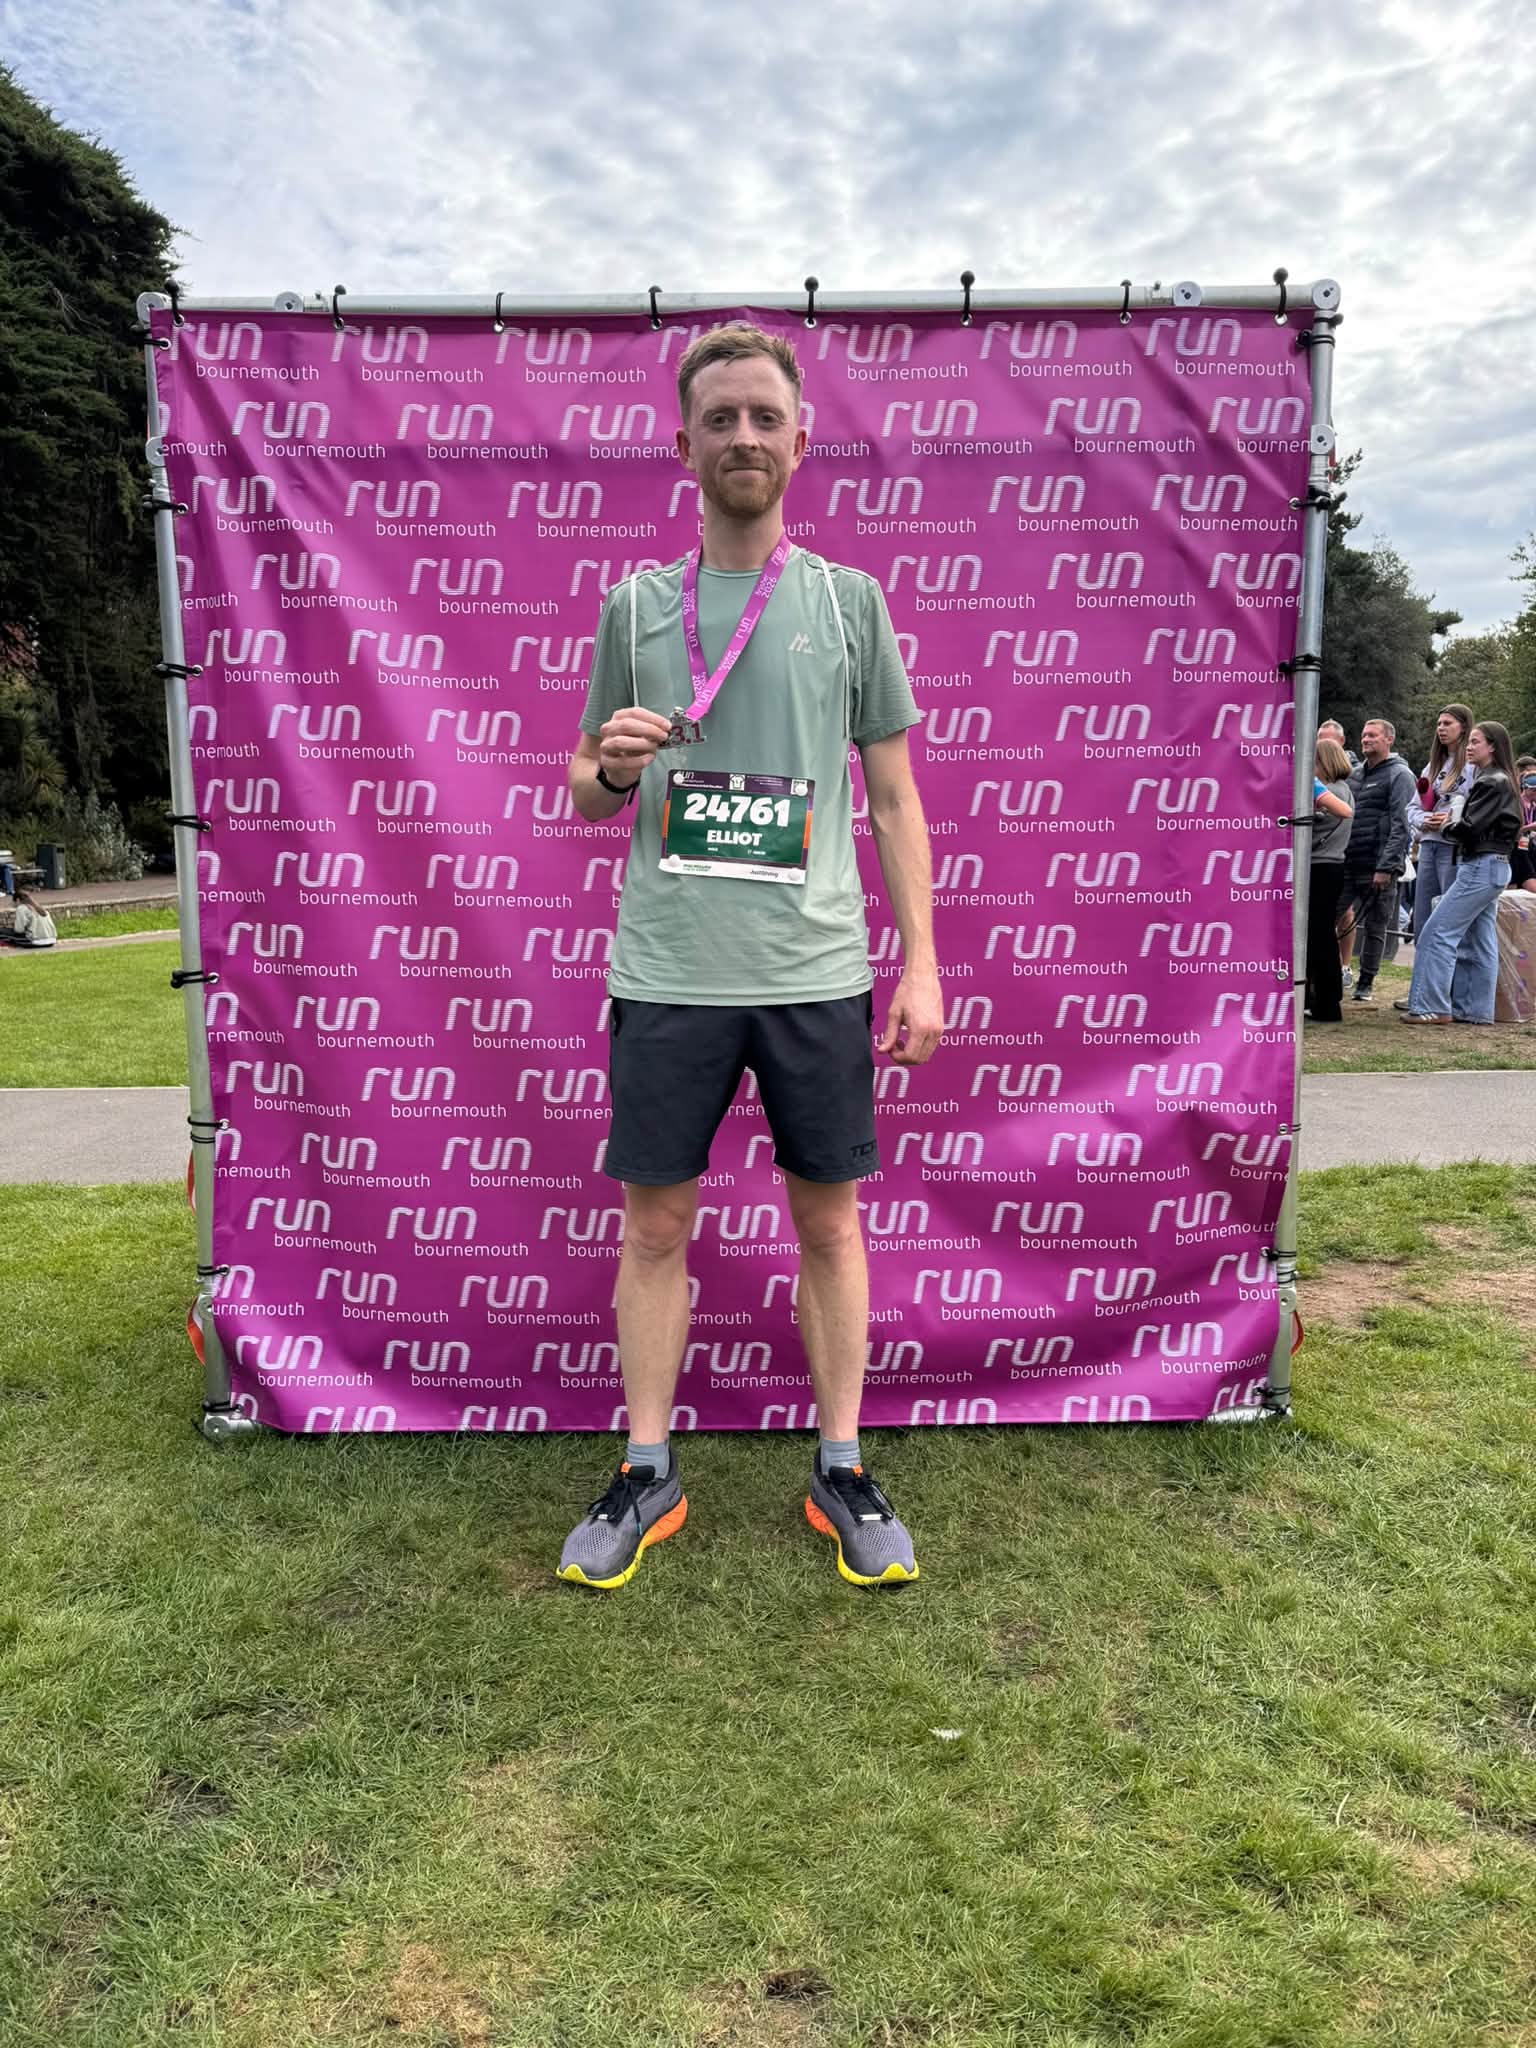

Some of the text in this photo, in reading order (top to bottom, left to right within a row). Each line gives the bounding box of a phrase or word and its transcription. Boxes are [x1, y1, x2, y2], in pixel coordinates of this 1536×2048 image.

[170, 321, 262, 361] run
[331, 324, 428, 363] run
[494, 328, 593, 365] run
[816, 322, 912, 363] run
[980, 321, 1078, 360] run
[1145, 319, 1242, 356] run
[196, 362, 319, 380] bournemouth
[362, 366, 483, 382] bournemouth
[526, 367, 646, 383] bournemouth
[848, 362, 967, 380] bournemouth
[1011, 360, 1132, 377] bournemouth
[1175, 360, 1295, 376] bournemouth
[232, 401, 330, 439] run
[397, 404, 494, 440] run
[560, 404, 656, 440] run
[881, 400, 977, 437] run
[1043, 397, 1141, 435] run
[1208, 397, 1304, 434] run
[264, 442, 385, 460] bournemouth
[428, 444, 548, 458] bournemouth
[912, 439, 1032, 455] bournemouth
[1075, 437, 1195, 452] bournemouth
[192, 475, 278, 515] run
[344, 480, 440, 518] run
[507, 481, 603, 519] run
[827, 477, 923, 516] run
[988, 475, 1085, 513] run
[1151, 474, 1247, 512] run
[216, 516, 334, 535] bournemouth
[376, 520, 495, 536] bournemouth
[538, 522, 656, 537] bournemouth
[857, 517, 976, 535] bournemouth
[1019, 515, 1138, 531] bournemouth
[1180, 515, 1297, 531] bournemouth
[251, 553, 341, 590] run
[771, 546, 785, 566] run
[1047, 552, 1144, 590] run
[1208, 553, 1299, 589] run
[408, 558, 504, 595] run
[887, 554, 983, 593] run
[281, 594, 397, 612] bournemouth
[440, 598, 558, 614] bournemouth
[916, 593, 1035, 611] bournemouth
[1077, 592, 1195, 608] bournemouth
[735, 617, 751, 639] run
[204, 628, 286, 667] run
[348, 629, 444, 670] run
[984, 630, 1079, 667] run
[1143, 628, 1236, 664] run
[224, 668, 339, 684] bournemouth
[378, 669, 499, 689] bournemouth
[1013, 668, 1131, 684] bournemouth
[1173, 667, 1285, 683] bournemouth
[268, 704, 361, 741] run
[426, 709, 521, 746] run
[1055, 704, 1151, 741] run
[299, 744, 414, 759] bournemouth
[457, 749, 575, 767] bournemouth
[927, 744, 1043, 761] bournemouth
[1084, 742, 1200, 758] bournemouth
[205, 778, 280, 813] run
[348, 780, 436, 816] run
[684, 793, 791, 827] 24761
[969, 780, 1063, 816] run
[1127, 777, 1220, 813] run
[229, 816, 335, 832] bournemouth
[378, 818, 491, 835] bournemouth
[706, 830, 762, 846] ELLIOT
[999, 817, 1114, 833] bournemouth
[1157, 815, 1271, 831] bournemouth
[273, 852, 365, 887] run
[426, 854, 519, 890] run
[1045, 852, 1140, 887] run
[1202, 848, 1293, 885] run
[300, 890, 417, 905] bournemouth
[454, 892, 572, 908] bournemouth
[1075, 888, 1191, 904] bournemouth
[224, 922, 304, 958] run
[369, 925, 459, 960] run
[522, 928, 613, 962] run
[984, 924, 1076, 959] run
[1139, 922, 1232, 957] run
[253, 959, 357, 977] bournemouth
[400, 962, 511, 978] bournemouth
[1013, 960, 1127, 976] bournemouth
[1169, 959, 1288, 975] bournemouth
[293, 996, 380, 1031] run
[445, 997, 533, 1032] run
[1054, 994, 1148, 1028] run
[318, 1033, 434, 1048] bournemouth
[473, 1034, 585, 1049] bournemouth
[1083, 1030, 1200, 1044] bournemouth
[225, 1061, 304, 1096] run
[360, 1067, 455, 1101] run
[516, 1068, 607, 1103] run
[970, 1064, 1062, 1096] run
[1125, 1062, 1223, 1096] run
[254, 1096, 350, 1117] bournemouth
[392, 1104, 506, 1118] bournemouth
[999, 1099, 1114, 1113] bournemouth
[1157, 1099, 1277, 1114] bournemouth
[300, 1133, 377, 1170] run
[441, 1137, 532, 1170] run
[894, 1132, 984, 1165] run
[1047, 1132, 1143, 1166] run
[323, 1170, 430, 1188] bournemouth
[470, 1173, 582, 1189] bournemouth
[922, 1168, 1036, 1182] bournemouth
[1077, 1164, 1189, 1183] bournemouth
[246, 1197, 331, 1232] run
[386, 1206, 477, 1240] run
[539, 1207, 623, 1241] run
[692, 1204, 780, 1240] run
[991, 1201, 1084, 1233] run
[1148, 1191, 1230, 1232] run
[275, 1233, 376, 1254] bournemouth
[415, 1242, 528, 1256] bournemouth
[868, 1235, 980, 1252] bournemouth
[1021, 1236, 1137, 1249] bournemouth
[316, 1268, 397, 1306] run
[459, 1275, 548, 1308] run
[912, 1268, 1002, 1304] run
[1065, 1268, 1157, 1302] run
[342, 1304, 448, 1323] bournemouth
[488, 1311, 599, 1324] bournemouth
[941, 1304, 1055, 1320] bournemouth
[1094, 1290, 1200, 1317] bournemouth
[237, 1335, 323, 1370] run
[984, 1336, 1074, 1368] run
[1132, 1322, 1223, 1357] run
[384, 1340, 471, 1372] run
[532, 1342, 620, 1373] run
[684, 1342, 772, 1373] run
[1010, 1362, 1122, 1379] bournemouth
[1161, 1354, 1265, 1374] bournemouth
[258, 1372, 372, 1386] bournemouth
[411, 1373, 521, 1388] bournemouth
[304, 1406, 398, 1432] run
[460, 1406, 547, 1432] run
[909, 1397, 997, 1424] run
[1061, 1395, 1151, 1422] run
